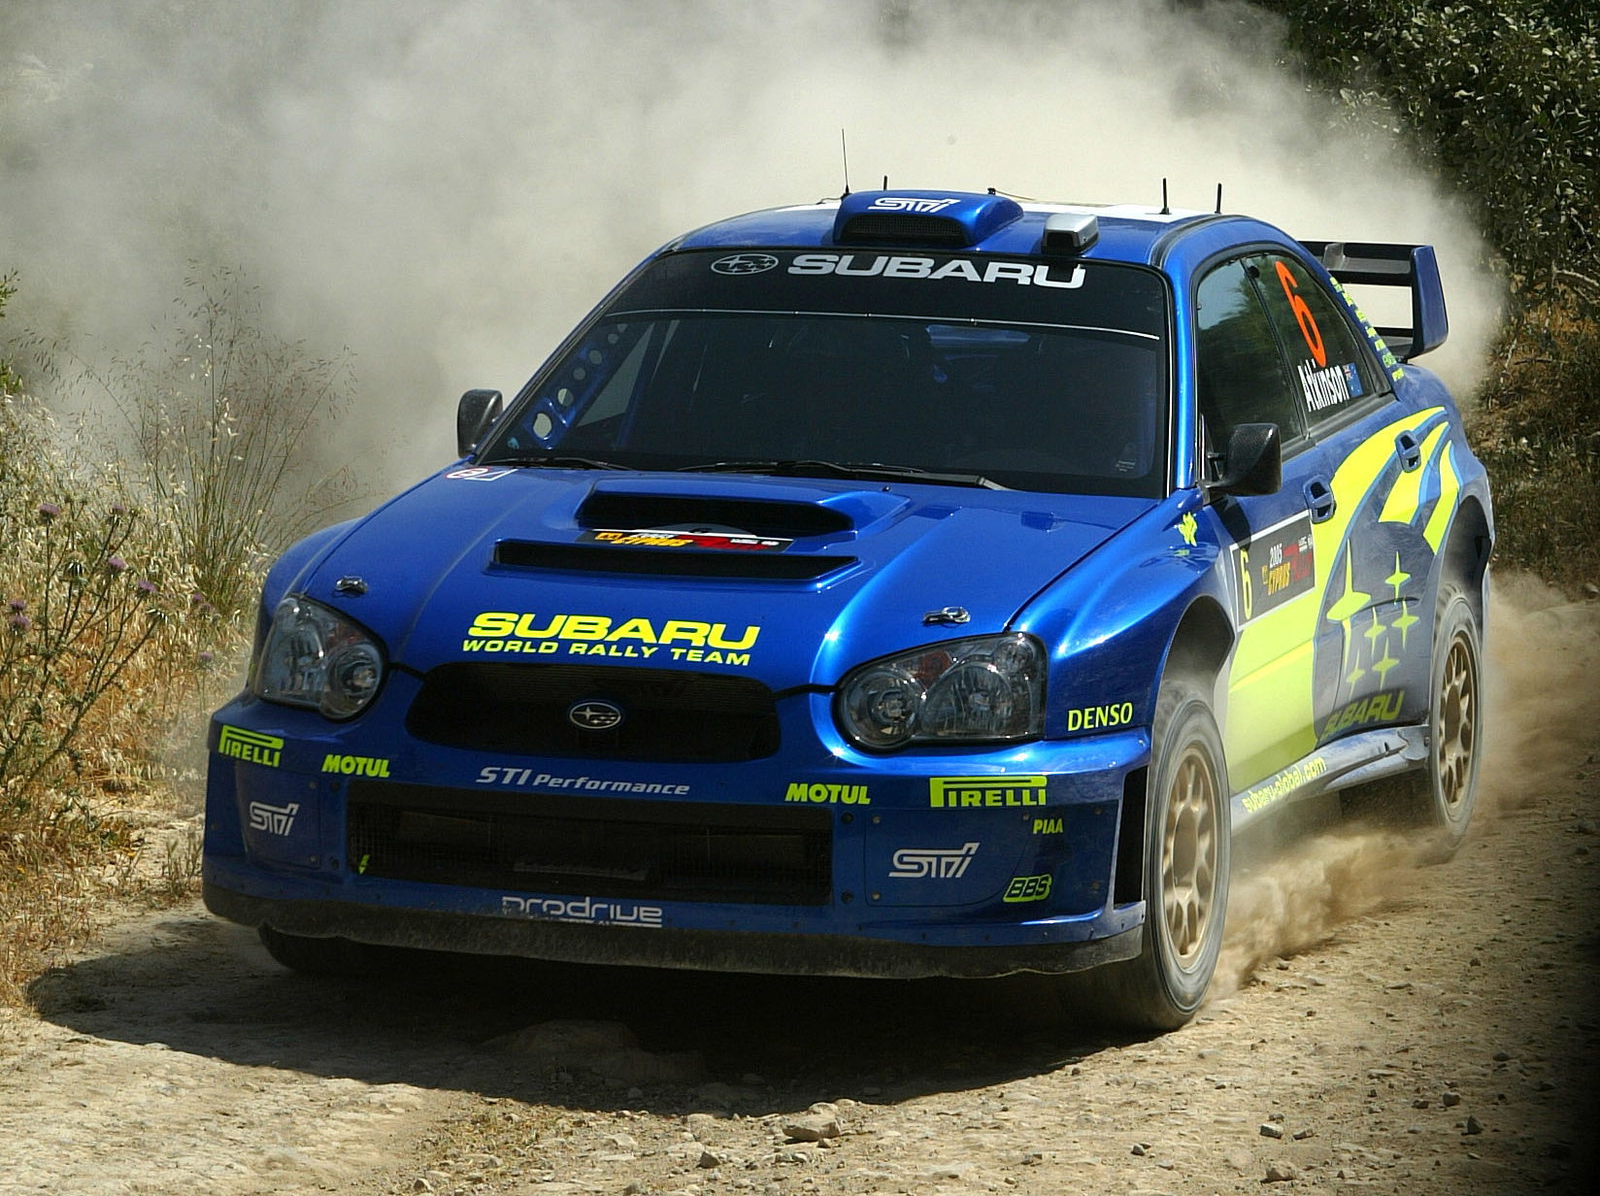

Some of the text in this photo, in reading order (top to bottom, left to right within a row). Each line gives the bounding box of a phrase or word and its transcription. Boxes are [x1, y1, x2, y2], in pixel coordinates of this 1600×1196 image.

[787, 254, 1086, 290] SUBARU
[1275, 260, 1327, 367] 6
[1297, 358, 1350, 413] Atkinson
[1240, 548, 1253, 620] 6
[468, 612, 760, 650] SUBARU
[462, 639, 751, 667] WORLD RALLY TEAM
[1067, 702, 1133, 732] DENSO
[218, 724, 285, 768] PIRELLI
[321, 754, 391, 778] MOTUL
[475, 767, 690, 795] STI Performance
[785, 783, 871, 805] MOTUL
[929, 776, 1047, 808] PIRELLI
[1033, 818, 1064, 835] PIAA
[1006, 875, 1050, 900] BBS
